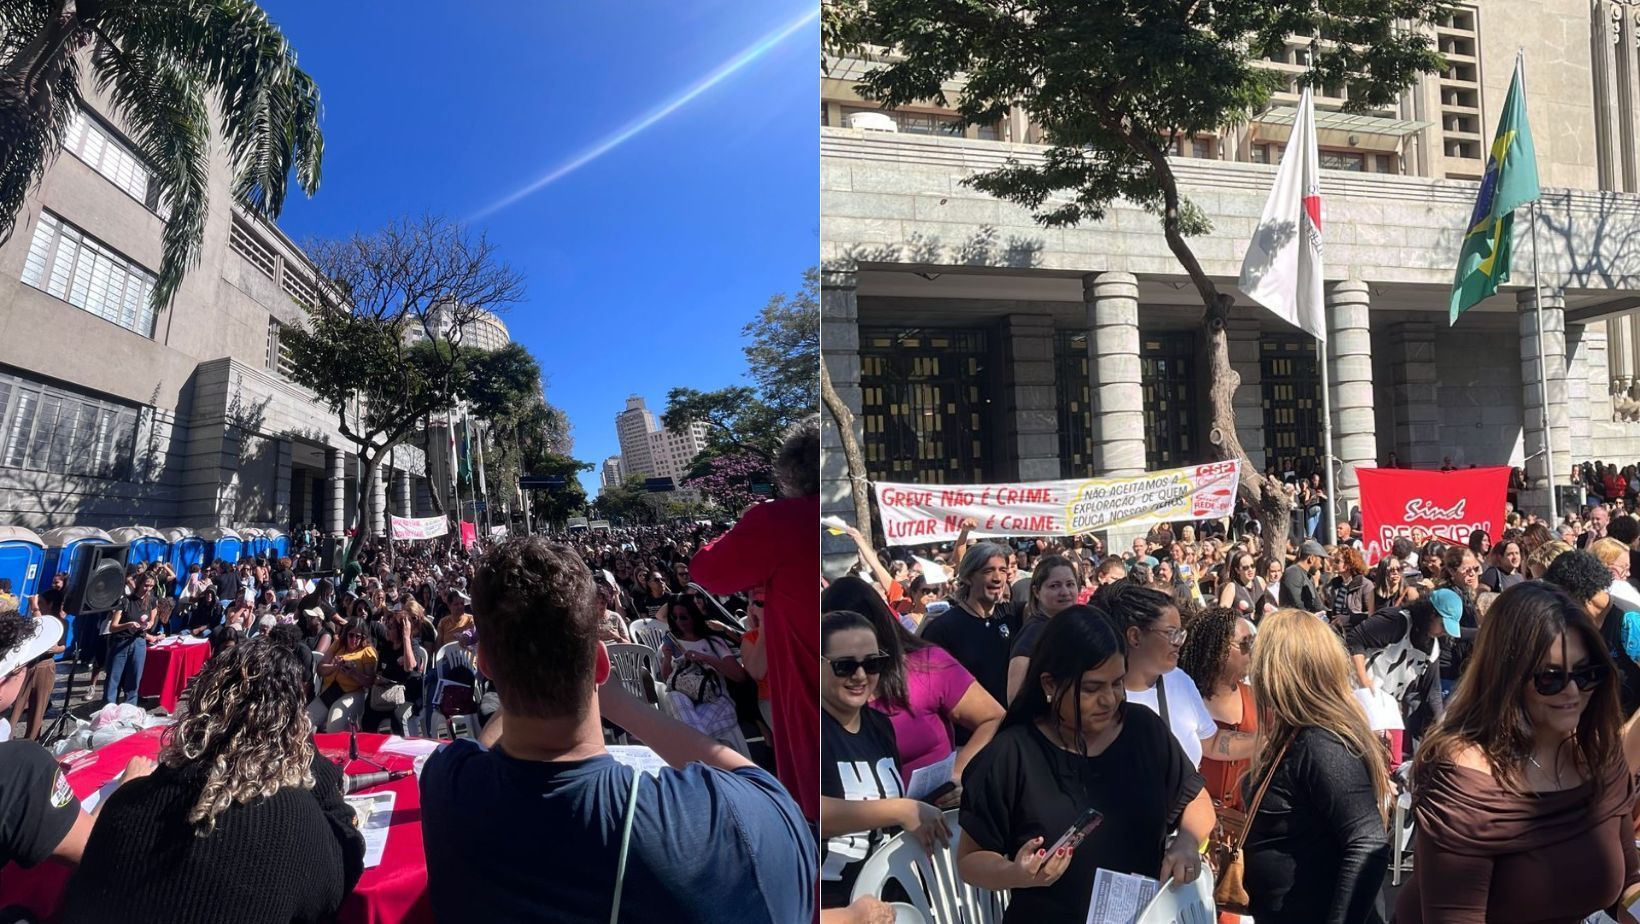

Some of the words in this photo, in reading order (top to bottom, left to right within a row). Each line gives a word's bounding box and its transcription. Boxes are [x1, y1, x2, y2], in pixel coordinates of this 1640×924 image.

[1199, 463, 1232, 477] CSP
[881, 487, 933, 507] GREVE
[981, 487, 991, 506] É
[996, 487, 1059, 506] CRIME.
[1084, 487, 1106, 500] NÃO
[1110, 476, 1169, 497] ACEITAMOS
[1171, 474, 1179, 485] A
[1142, 492, 1154, 503] DE
[1158, 484, 1188, 501] QUEM
[1072, 512, 1105, 528] EDUCA
[1403, 498, 1466, 522] Sind
[888, 518, 937, 538] LUTAR
[985, 514, 996, 530] É
[1000, 514, 1060, 531] CRIME.
